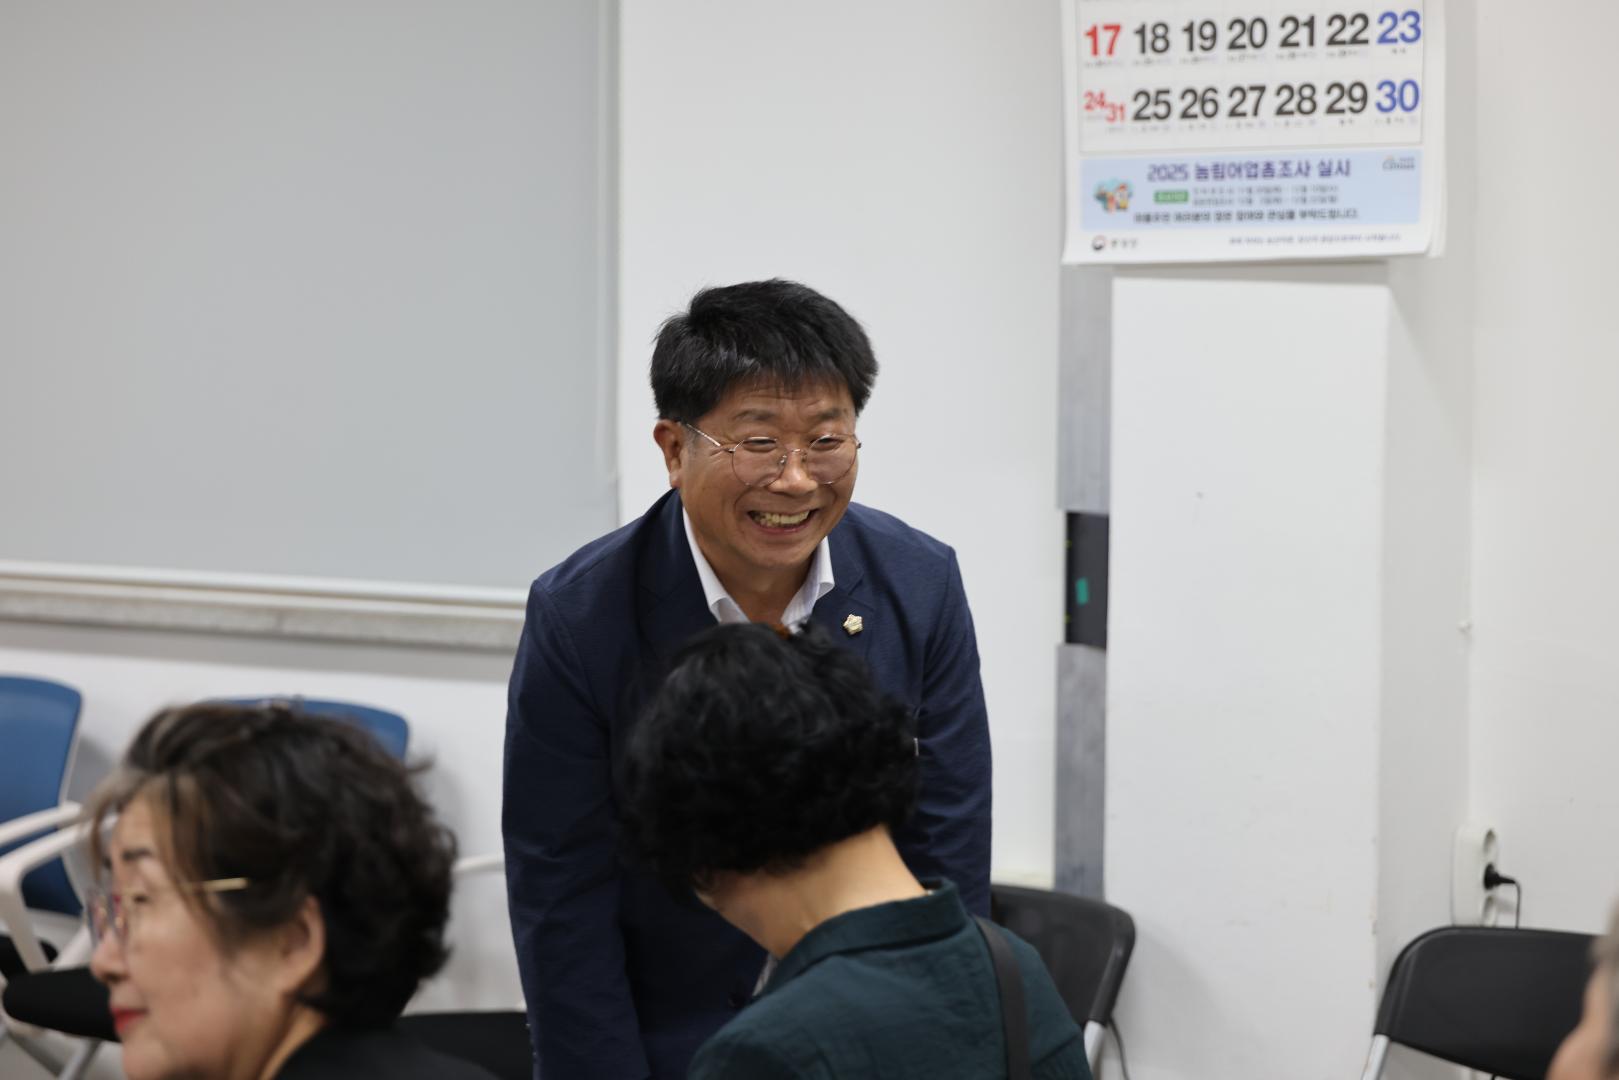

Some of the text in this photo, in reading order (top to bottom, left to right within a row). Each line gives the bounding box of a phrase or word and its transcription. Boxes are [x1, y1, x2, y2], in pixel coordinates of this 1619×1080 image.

[1085, 10, 1422, 56] 17 18 19 20 21 22 23
[1084, 79, 1420, 122] 24 31 25 26 27 28 29 30
[1147, 158, 1351, 181] 2025 농림어업총조사 실시
